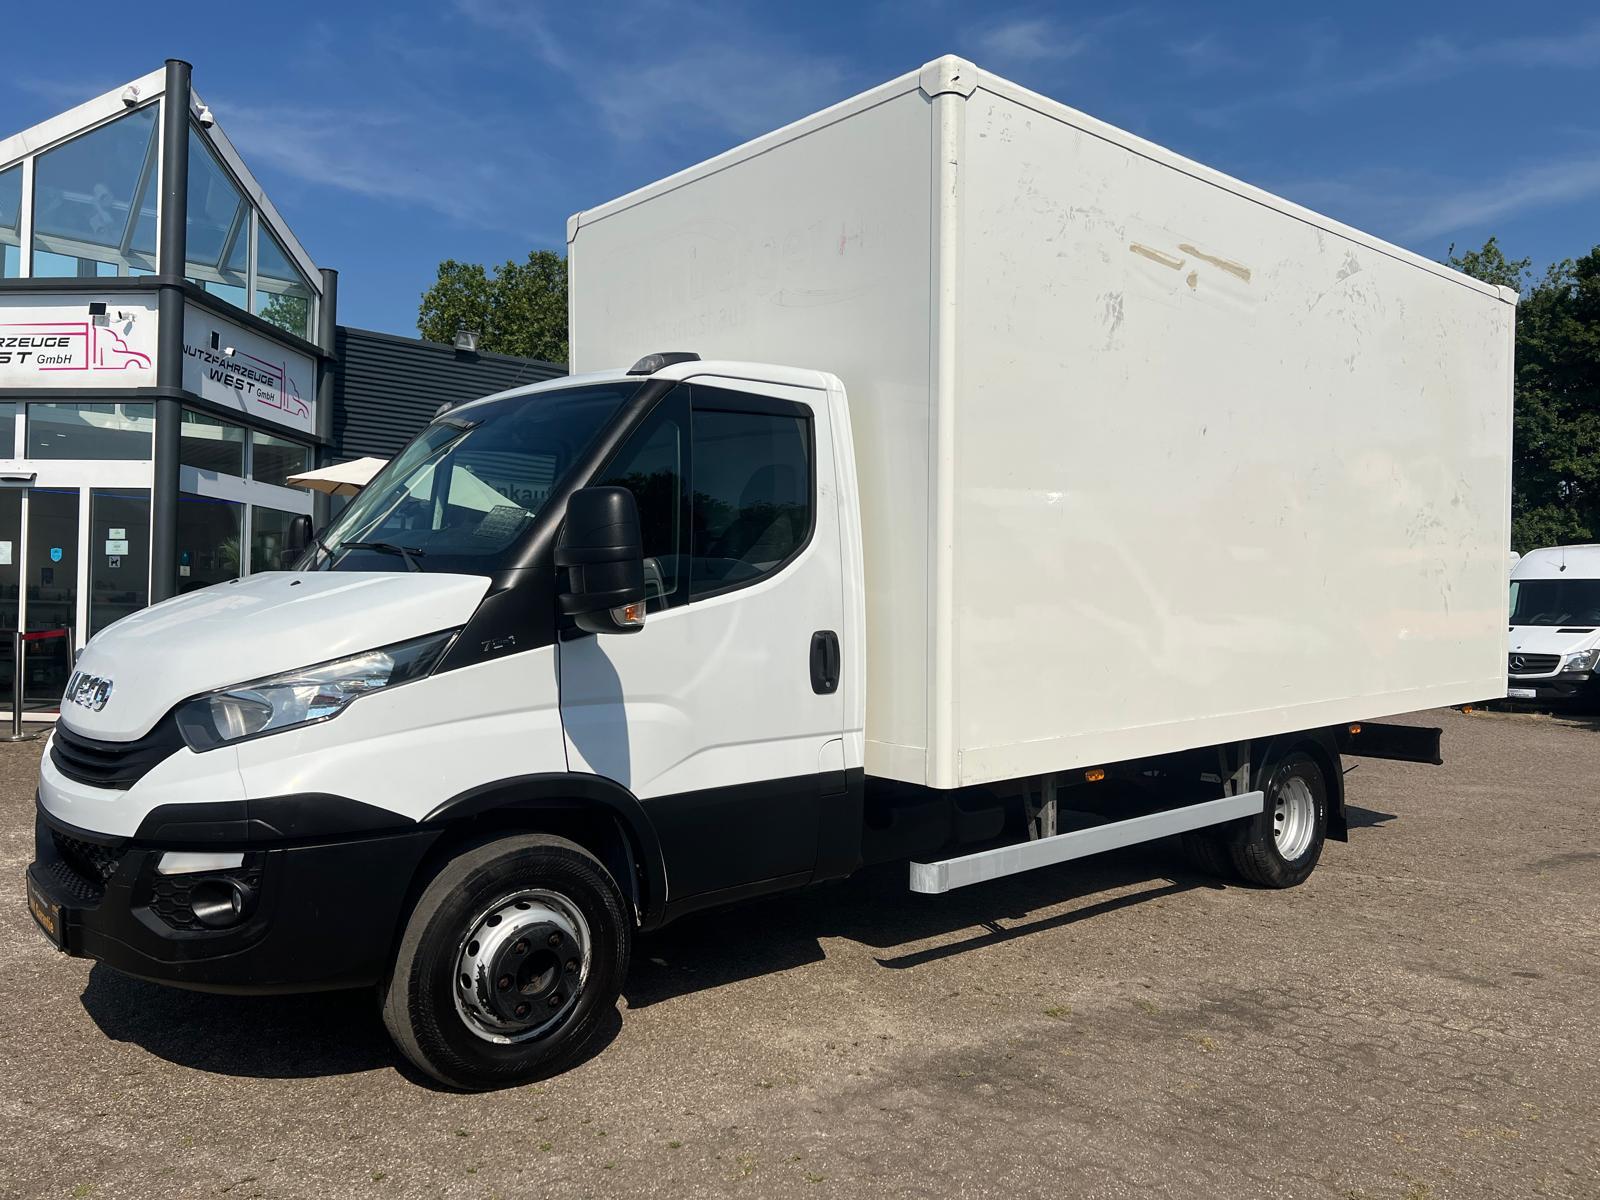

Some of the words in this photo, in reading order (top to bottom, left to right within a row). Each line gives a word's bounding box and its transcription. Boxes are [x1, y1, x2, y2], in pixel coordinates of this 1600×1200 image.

[37, 354, 72, 364] GmbH
[209, 368, 255, 394] WEST
[256, 388, 275, 401] GmbH
